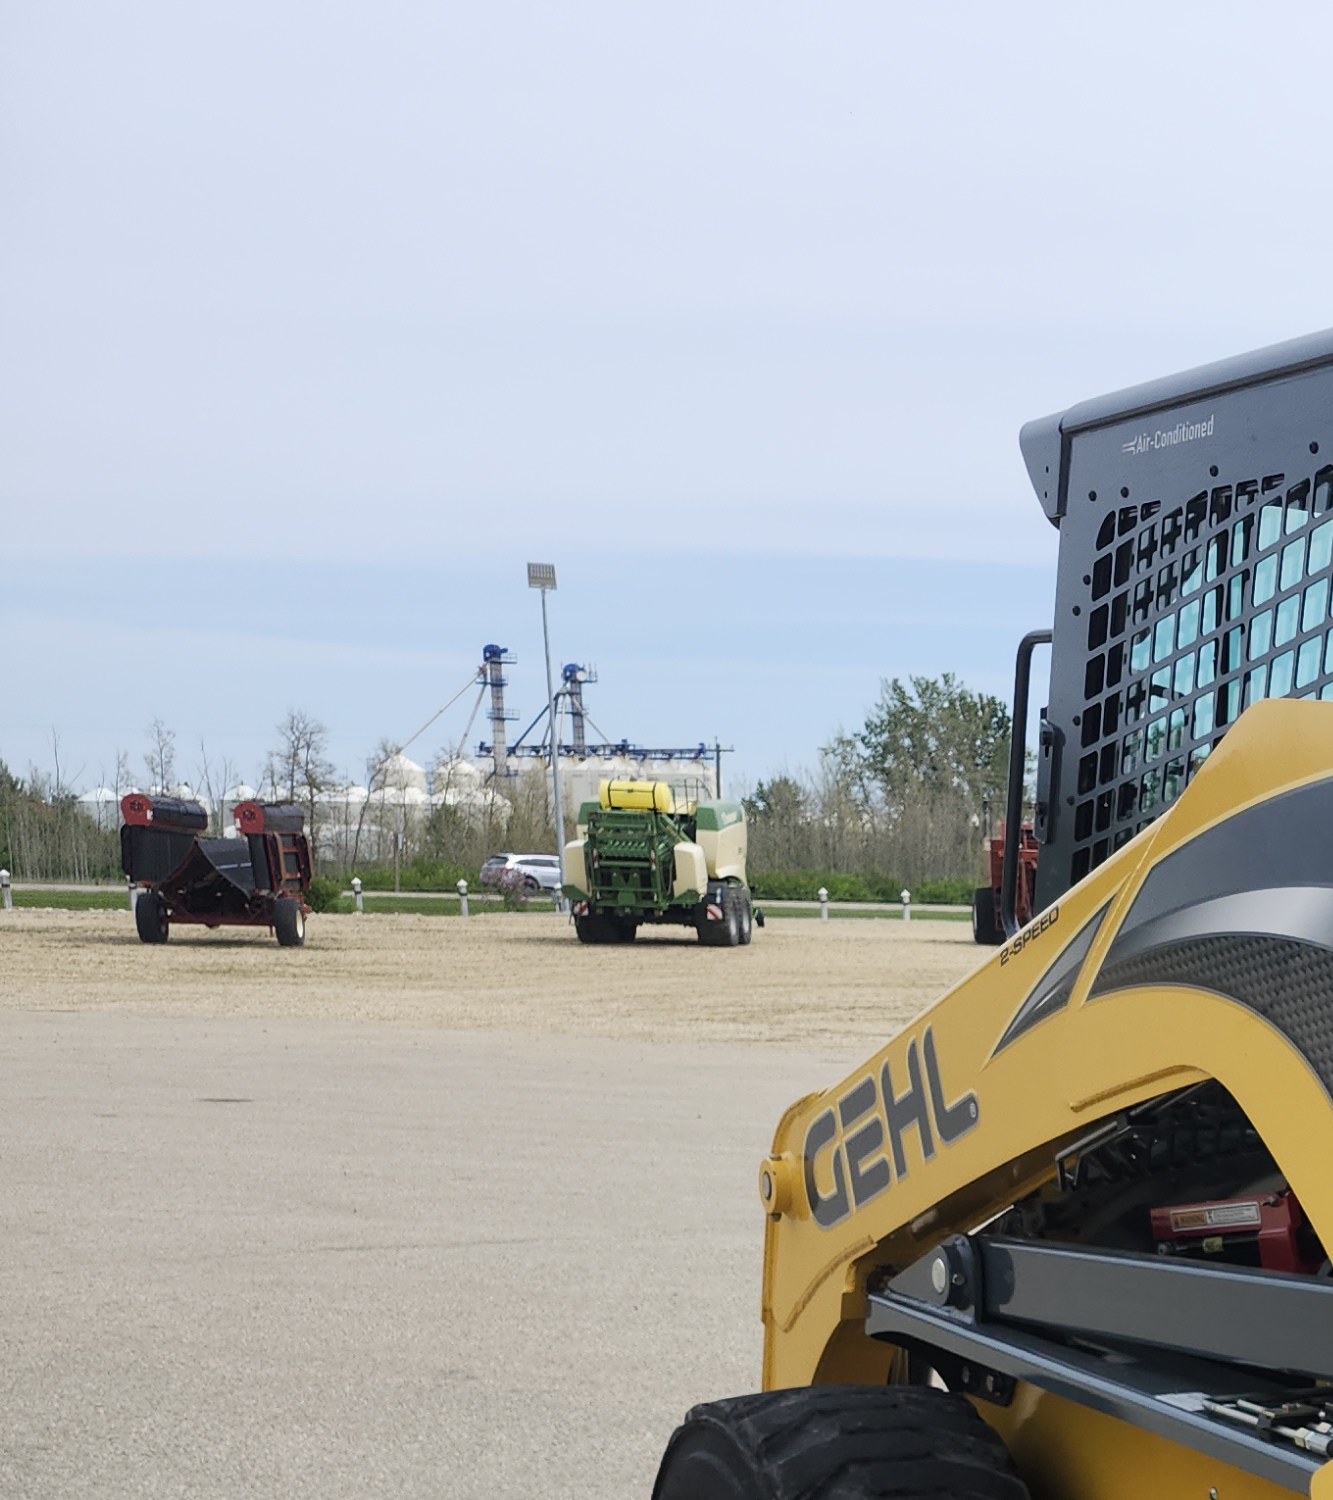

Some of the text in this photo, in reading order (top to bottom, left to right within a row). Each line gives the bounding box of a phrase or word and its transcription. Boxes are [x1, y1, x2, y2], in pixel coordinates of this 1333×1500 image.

[1136, 413, 1215, 454] Air-Conditioned
[999, 904, 1060, 967] 2-SPEED
[803, 1022, 980, 1230] GEHL
